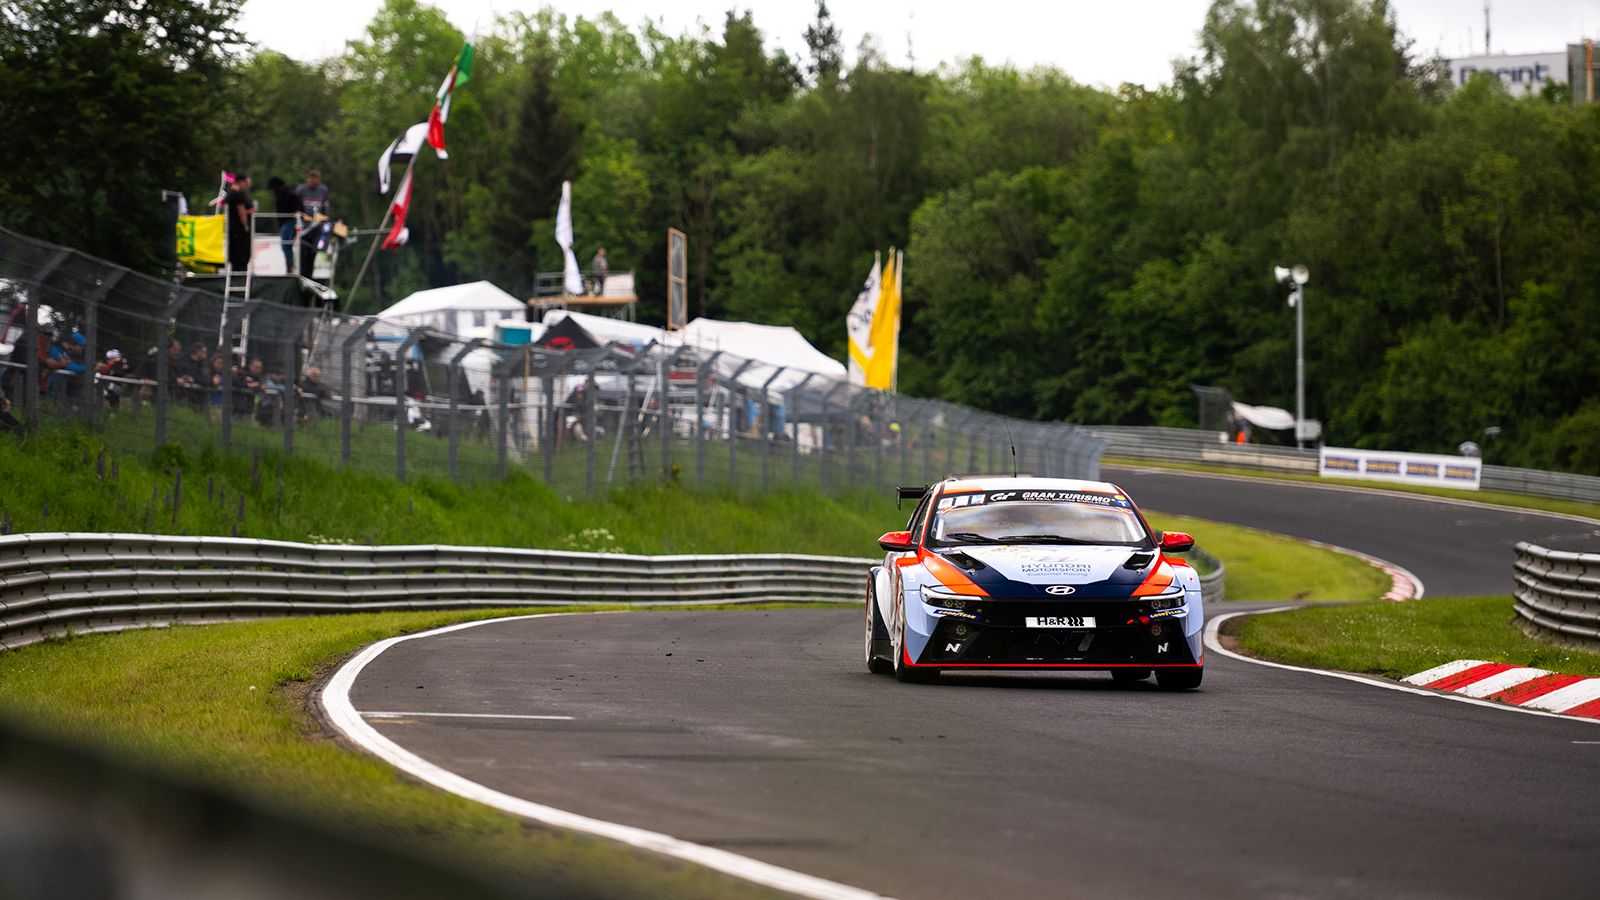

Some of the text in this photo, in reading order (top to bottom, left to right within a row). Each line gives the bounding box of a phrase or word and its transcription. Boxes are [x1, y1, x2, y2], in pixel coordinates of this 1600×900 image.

[1022, 491, 1111, 503] GRAN TURISMO
[938, 610, 976, 619] GOODYEAR
[1149, 610, 1182, 618] GOODYEAR
[1037, 616, 1067, 626] H&R
[944, 642, 961, 653] N
[1157, 642, 1169, 653] N
